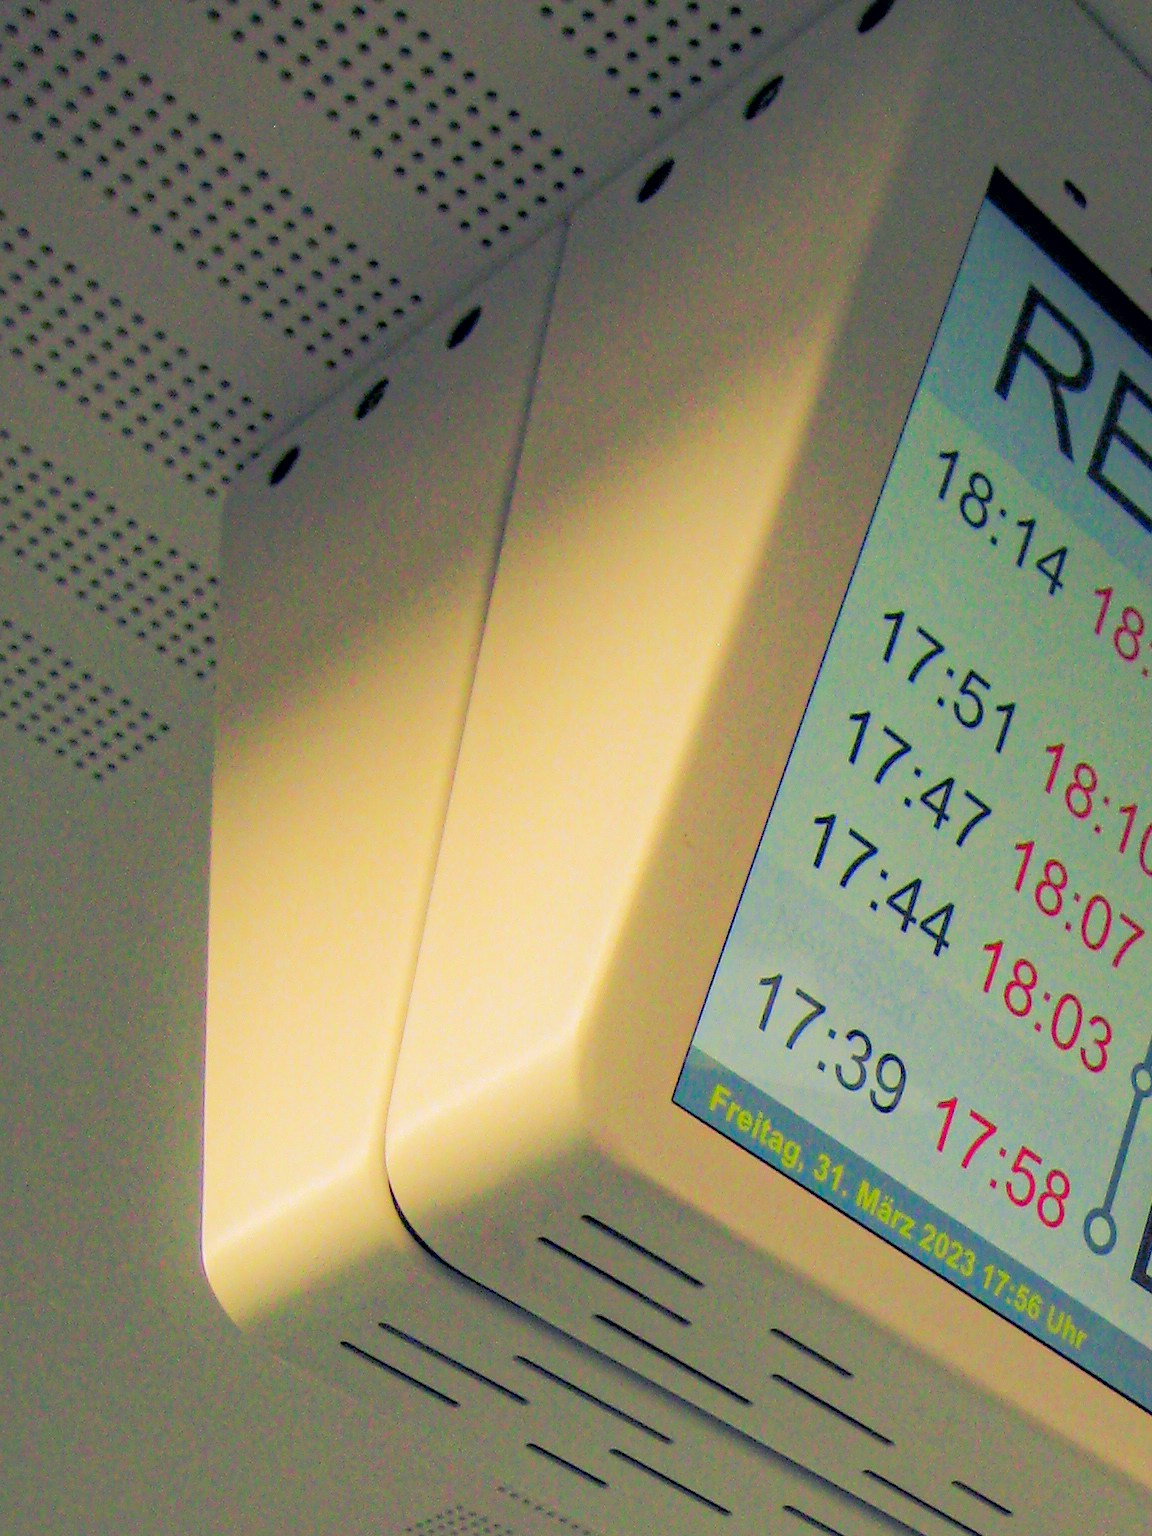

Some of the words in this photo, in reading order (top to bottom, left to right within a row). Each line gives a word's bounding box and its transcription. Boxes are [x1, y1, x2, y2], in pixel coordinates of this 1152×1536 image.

[938, 449, 1069, 596] 18:14
[883, 611, 1016, 754] 17:51
[813, 813, 956, 958] 17:44
[981, 940, 1113, 1074] 18:03
[848, 710, 992, 848] 17:47
[1013, 839, 1145, 969] 18:07
[708, 1083, 805, 1173] Freitag,
[813, 1153, 848, 1198] 31.
[856, 1179, 917, 1240] März
[918, 1222, 976, 1278] 2023
[983, 1263, 1044, 1321] 17:56
[1047, 1304, 1089, 1351] Uhr
[758, 973, 907, 1114] 17:39
[936, 1095, 1071, 1230] 17:58
